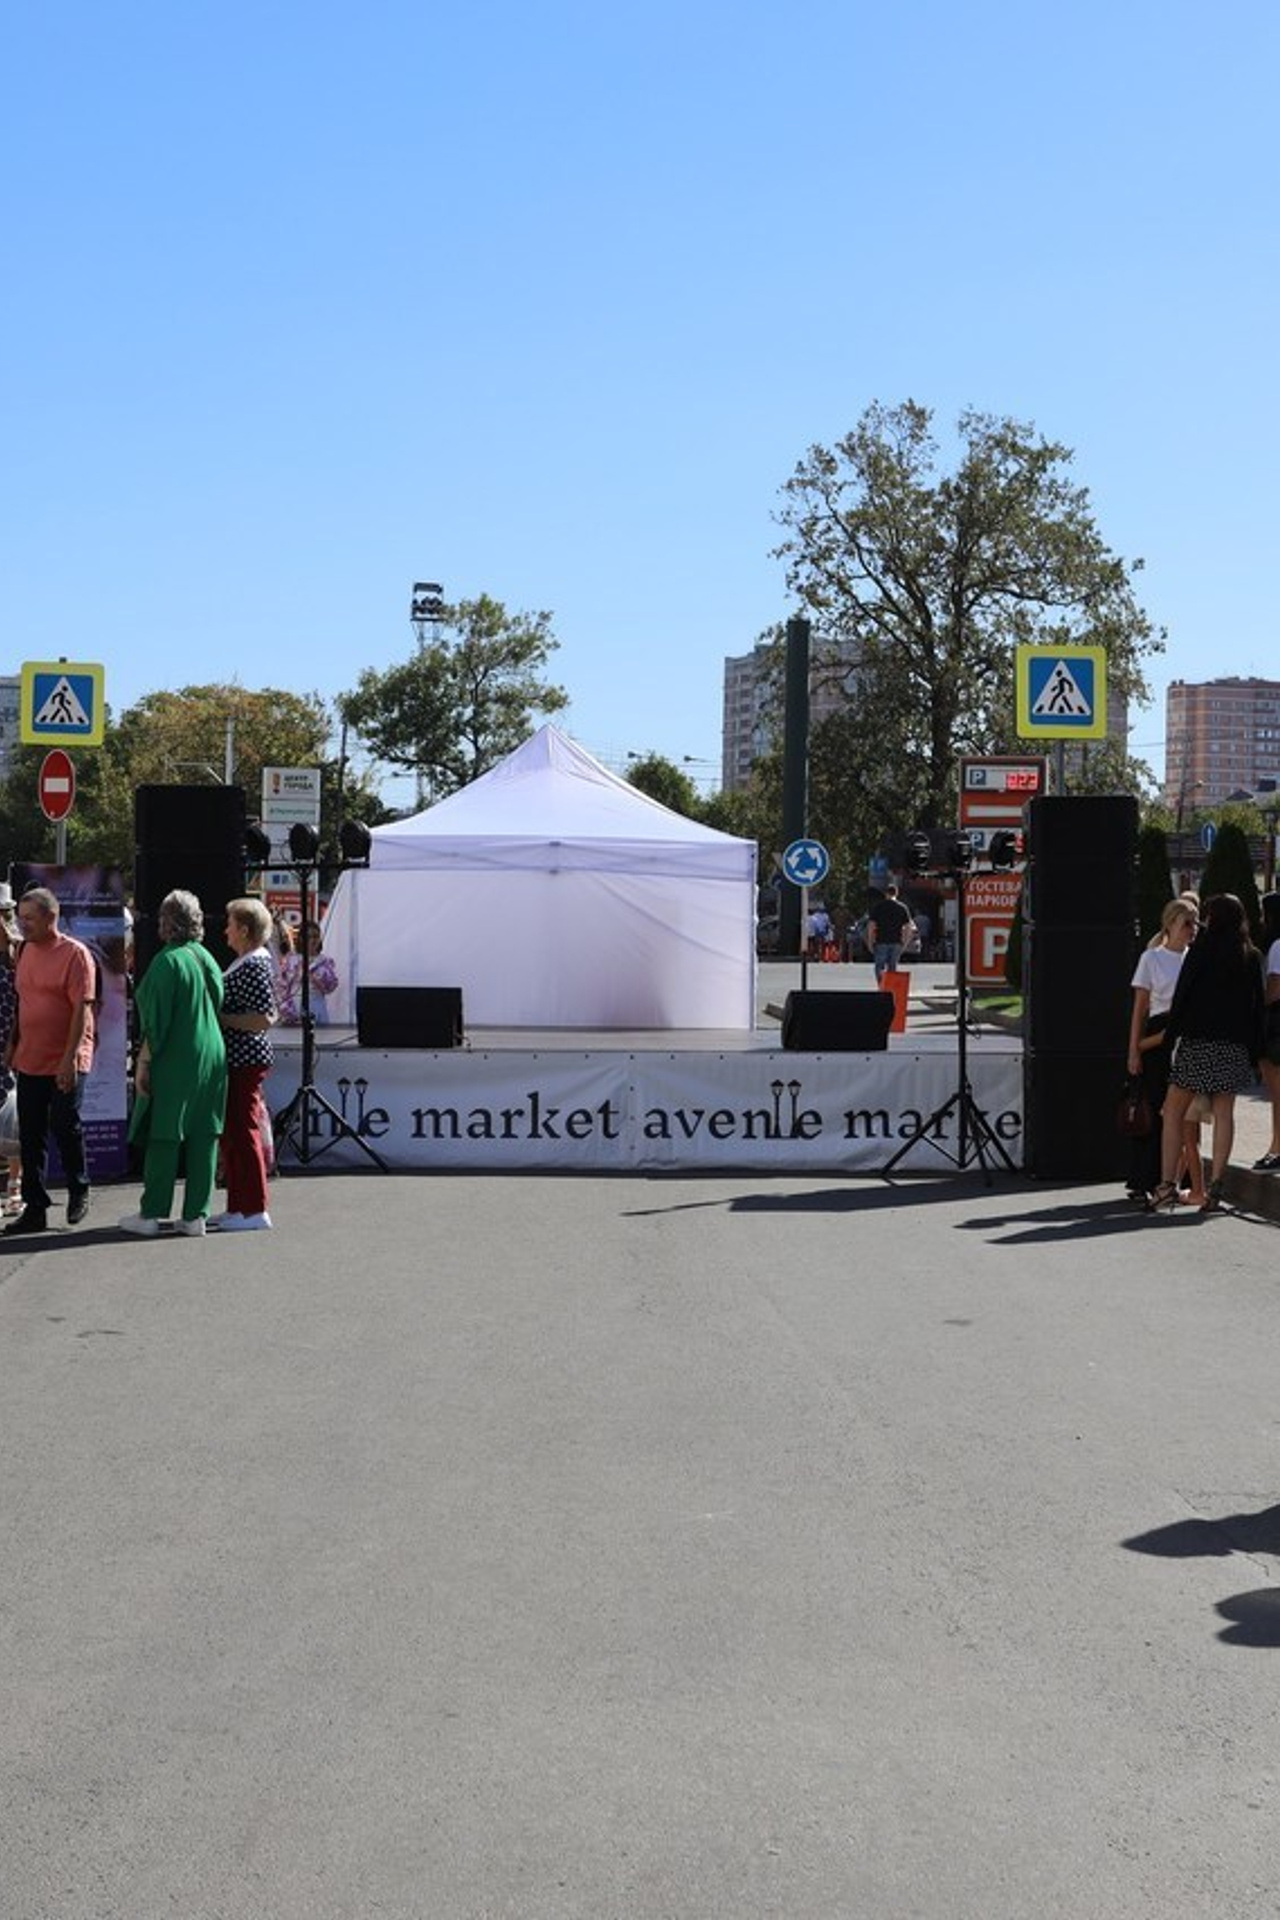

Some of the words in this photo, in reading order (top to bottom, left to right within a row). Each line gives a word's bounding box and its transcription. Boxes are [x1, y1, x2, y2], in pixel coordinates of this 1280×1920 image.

[971, 770, 984, 786] P
[968, 880, 1022, 892] ГОСТЕВА
[966, 894, 1018, 907] ПАРКОВ
[983, 926, 1011, 968] P
[410, 1090, 620, 1140] market
[643, 1079, 823, 1140] avenue
[843, 1108, 1022, 1140] mare
